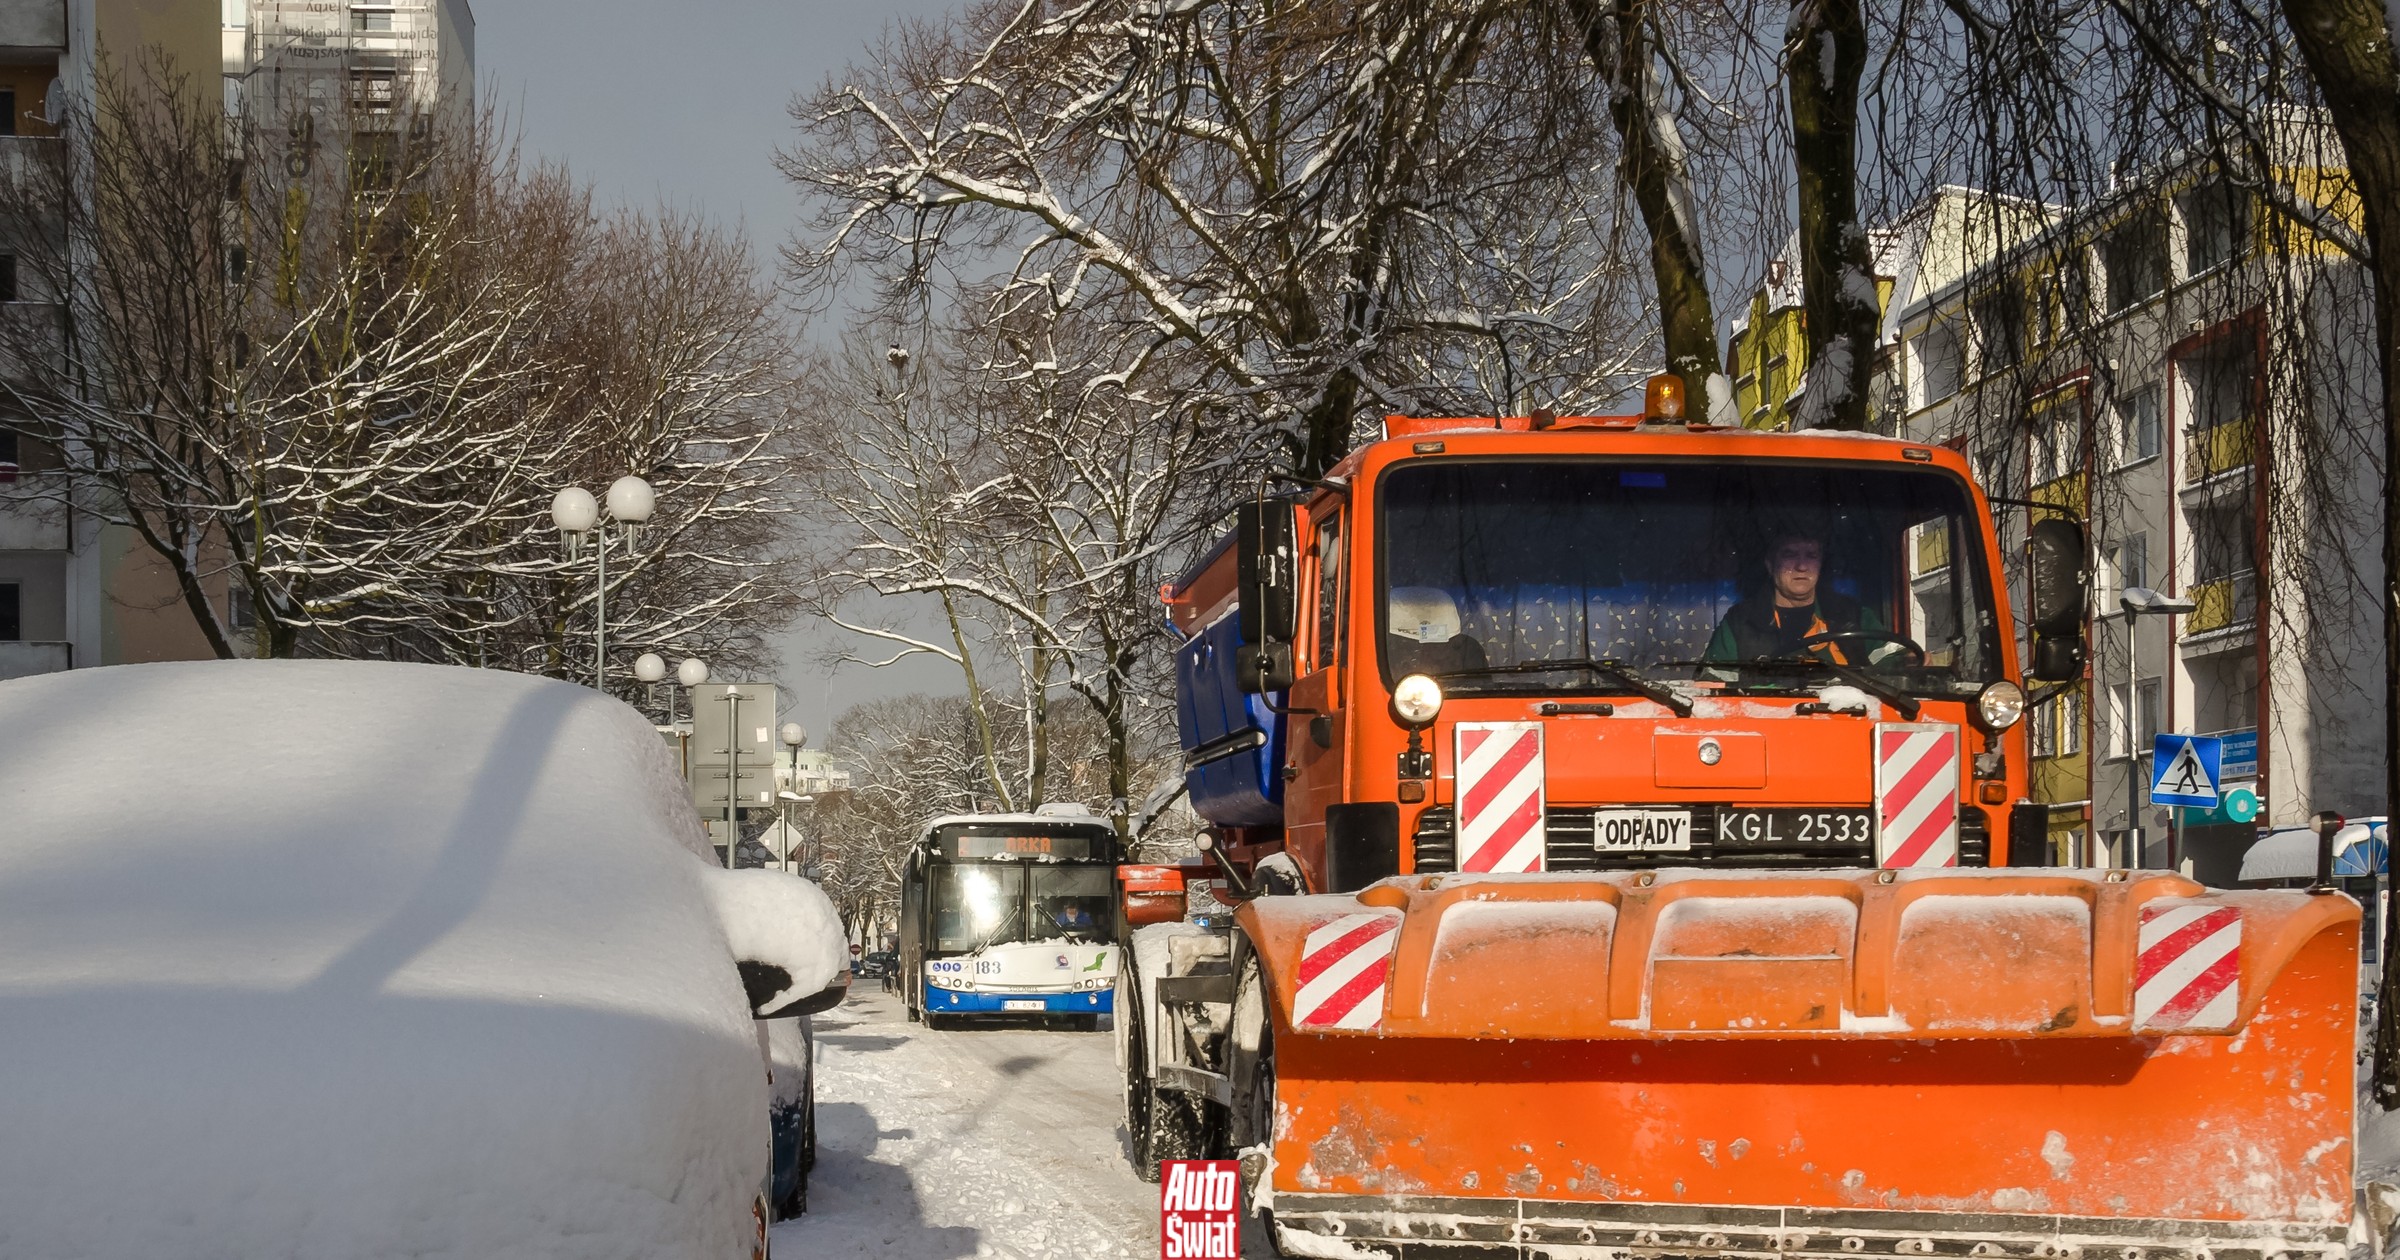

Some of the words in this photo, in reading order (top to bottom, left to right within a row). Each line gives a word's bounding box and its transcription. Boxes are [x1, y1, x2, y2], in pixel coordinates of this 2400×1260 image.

[1605, 818, 1682, 845] ODPADY
[1719, 813, 1782, 842] KGL
[1797, 813, 1870, 842] 2533
[1005, 836, 1051, 853] ARKA
[975, 961, 1002, 975] 183
